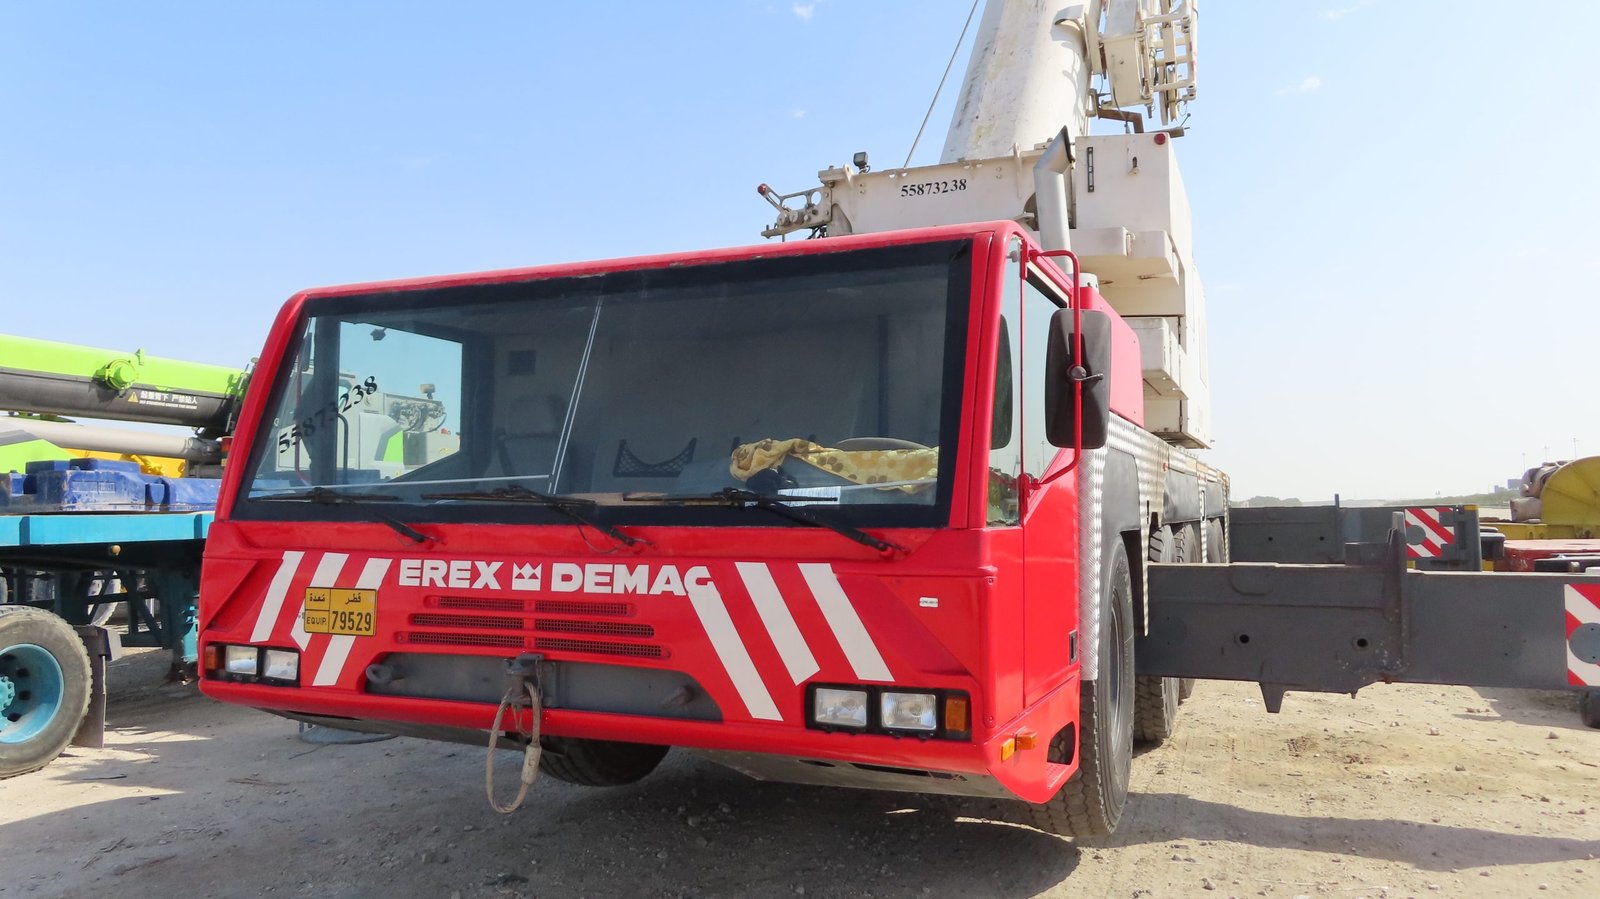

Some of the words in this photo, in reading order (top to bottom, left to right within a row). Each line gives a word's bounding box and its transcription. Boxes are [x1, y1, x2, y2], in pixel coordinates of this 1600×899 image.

[900, 179, 967, 197] 55873238
[279, 376, 378, 454] 55873238
[399, 559, 504, 590] EREX
[551, 562, 714, 597] DEMAG
[331, 610, 372, 632] 79529
